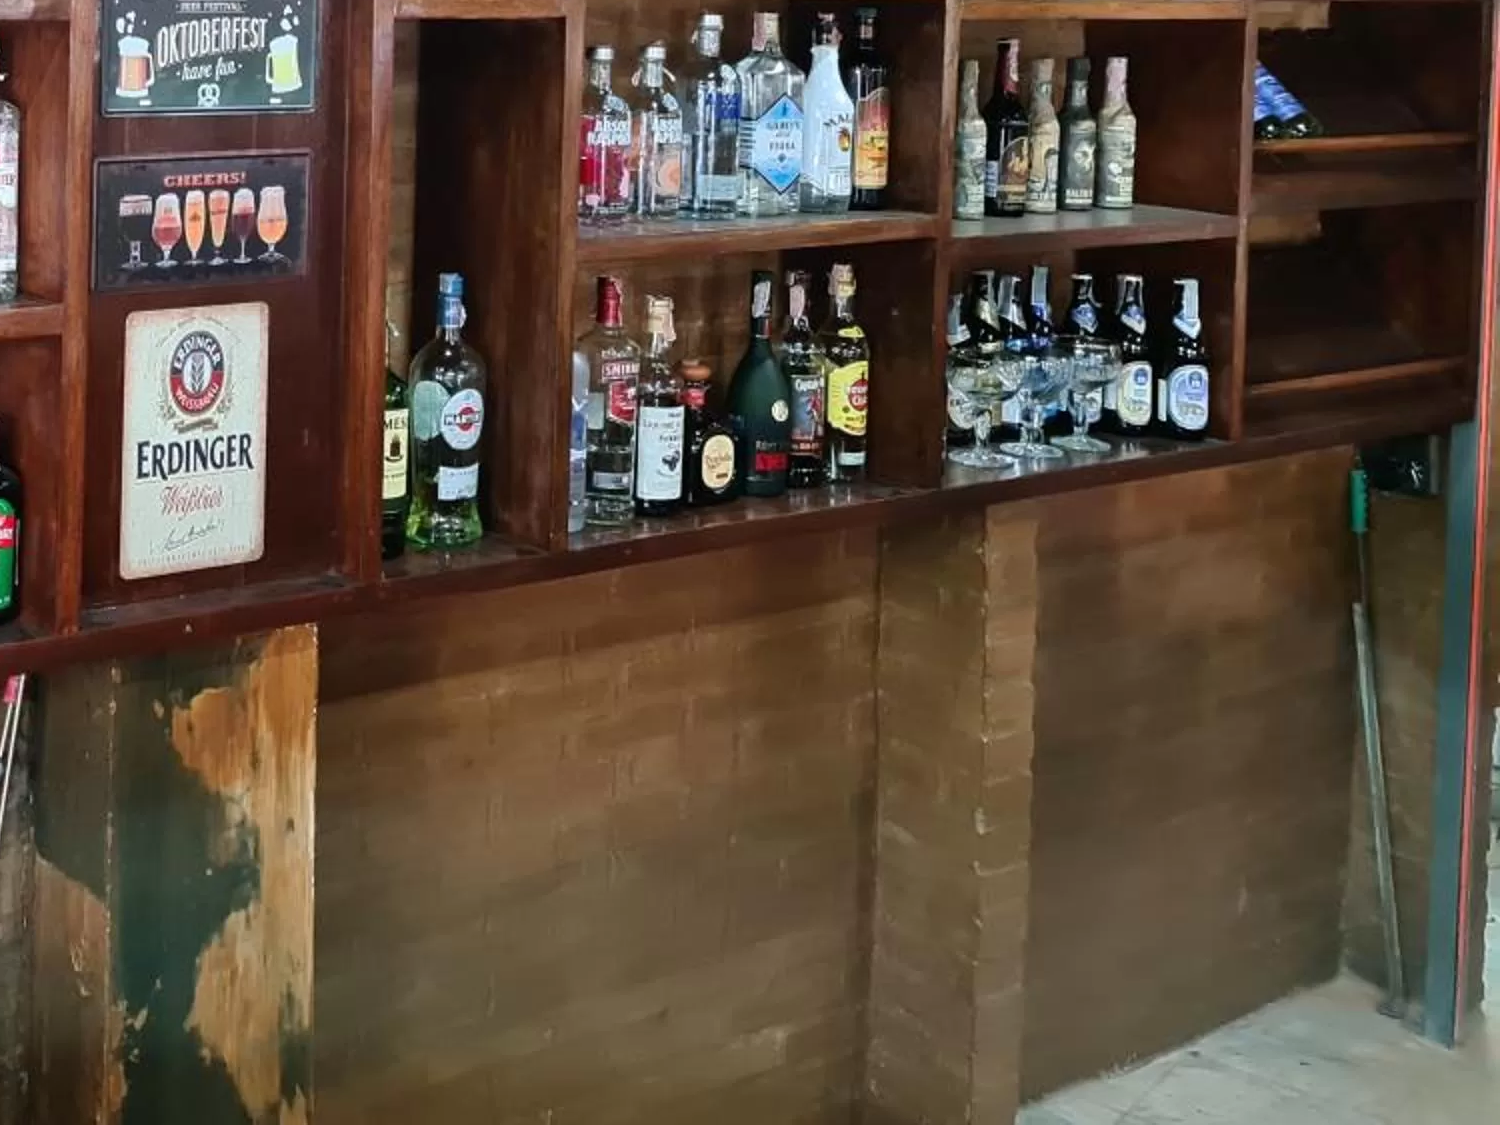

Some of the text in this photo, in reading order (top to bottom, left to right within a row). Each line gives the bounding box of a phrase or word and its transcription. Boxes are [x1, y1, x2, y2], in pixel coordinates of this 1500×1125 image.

[157, 16, 268, 68] OKTOBERFEST
[163, 171, 247, 188] CHEERS!
[137, 432, 254, 481] ERDINGER
